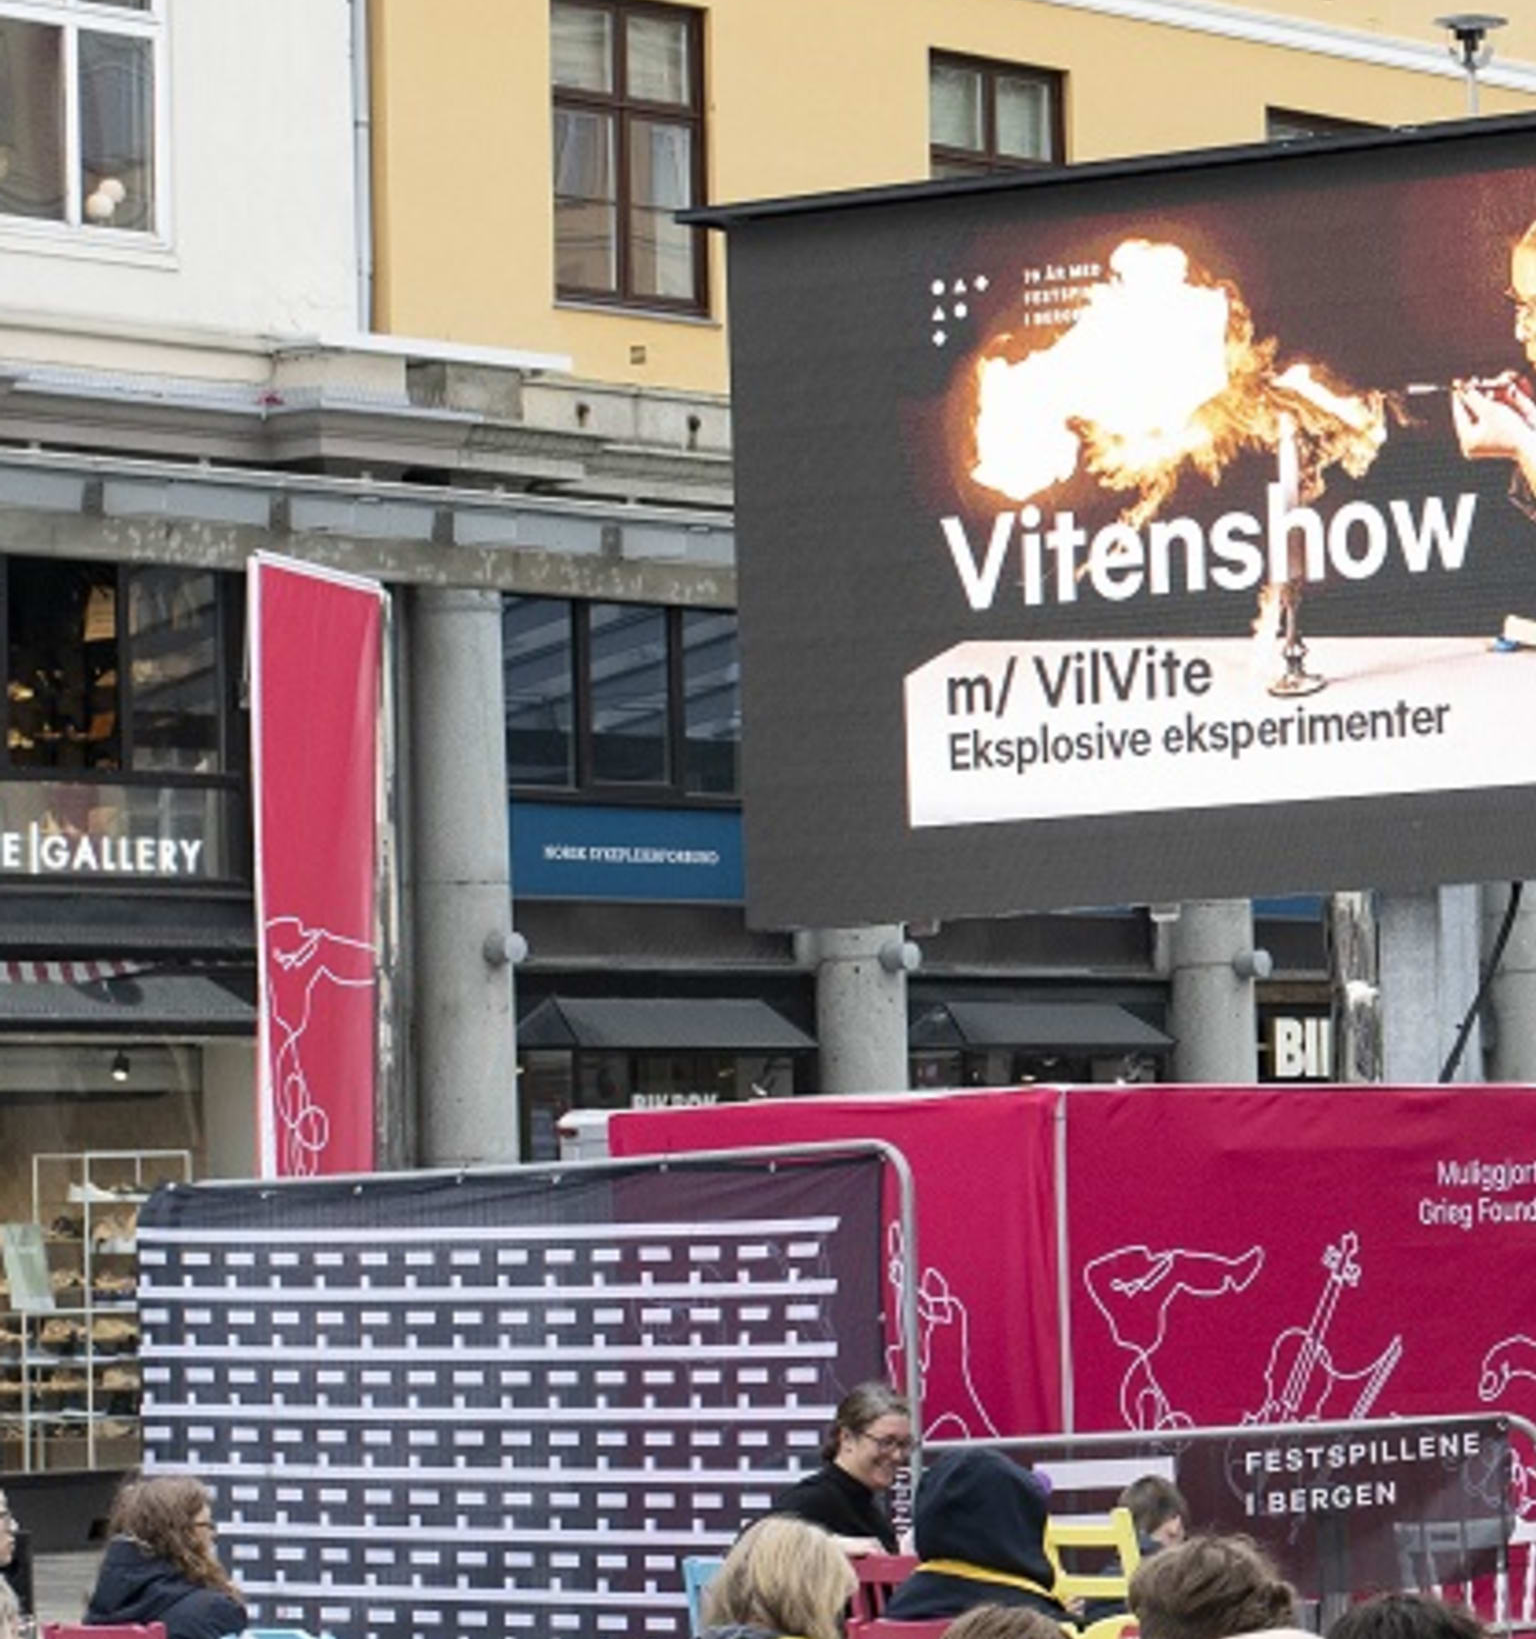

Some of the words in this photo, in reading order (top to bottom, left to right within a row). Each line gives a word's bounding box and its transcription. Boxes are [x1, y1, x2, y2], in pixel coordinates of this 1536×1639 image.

[940, 482, 1477, 611] Vitenshow
[946, 655, 1018, 718] m/
[1032, 646, 1213, 710] VilVite
[948, 721, 1152, 774] Eksplosive
[1163, 702, 1452, 760] eksperimenter
[39, 834, 203, 874] GALLERY
[1418, 1197, 1473, 1231] Grieg
[1244, 1432, 1481, 1475] FESTSPILLENE
[1244, 1492, 1256, 1516] I
[1266, 1481, 1397, 1514] BERGEN
